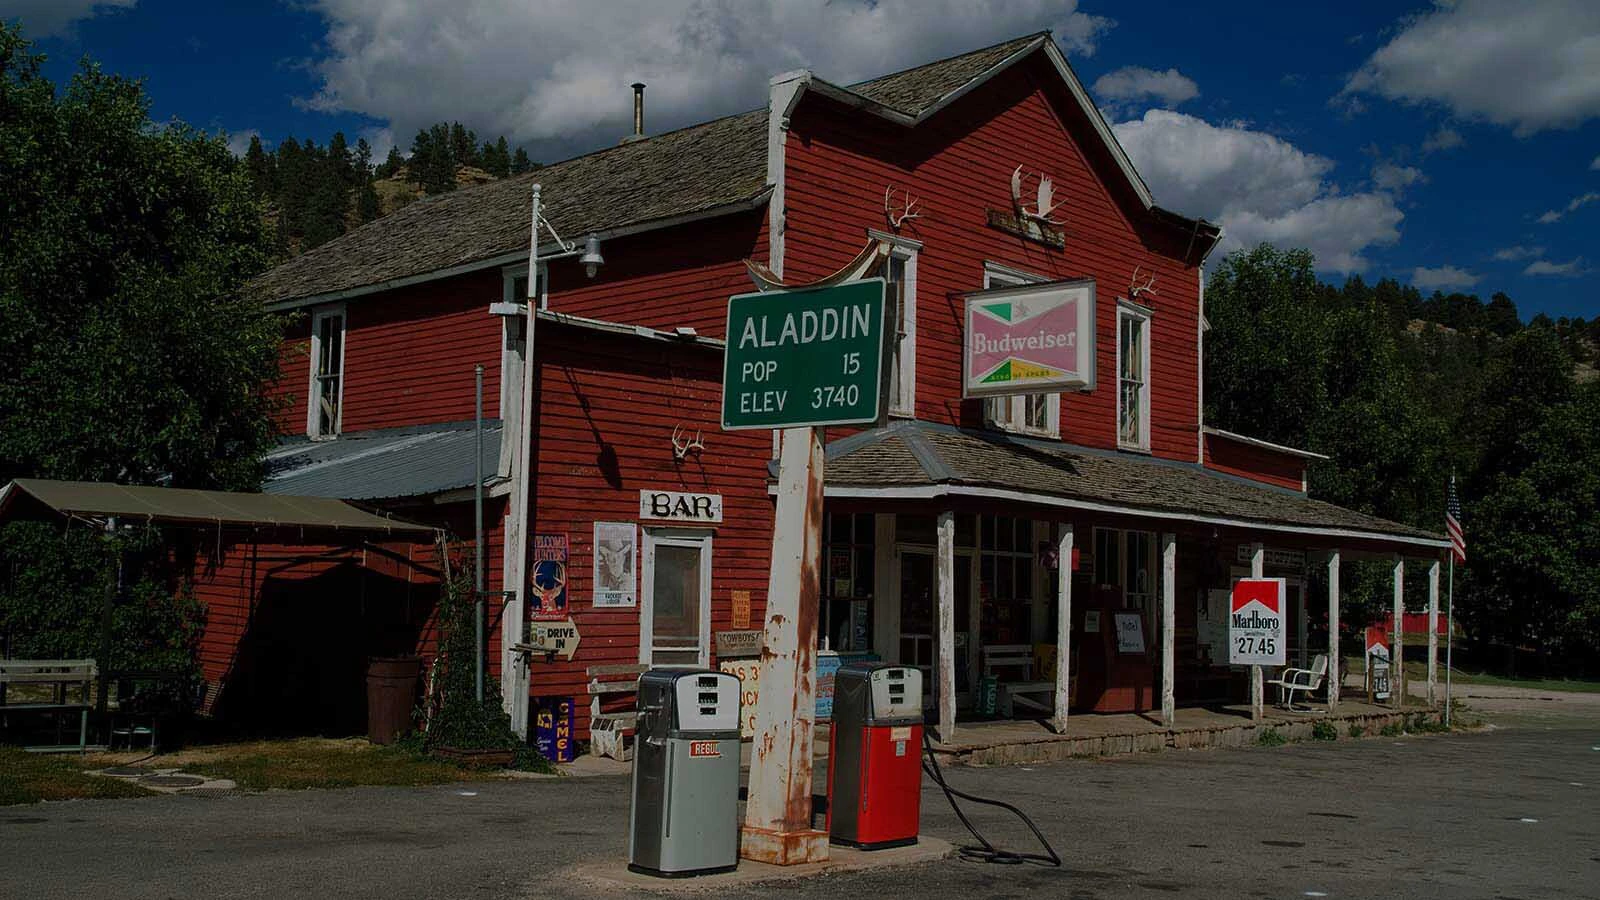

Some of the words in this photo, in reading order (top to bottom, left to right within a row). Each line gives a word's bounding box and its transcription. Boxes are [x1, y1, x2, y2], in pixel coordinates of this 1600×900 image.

[739, 303, 871, 349] ALADDIN
[974, 330, 1076, 354] Budweiser
[741, 360, 778, 383] POP
[842, 352, 861, 375] 15
[740, 390, 788, 413] ELEV
[811, 384, 859, 409] 3740
[651, 493, 714, 518] BAR
[1232, 610, 1279, 629] Marlboro
[547, 628, 574, 638] DRIVE
[555, 639, 565, 649] IN
[556, 702, 569, 761] CAMEL
